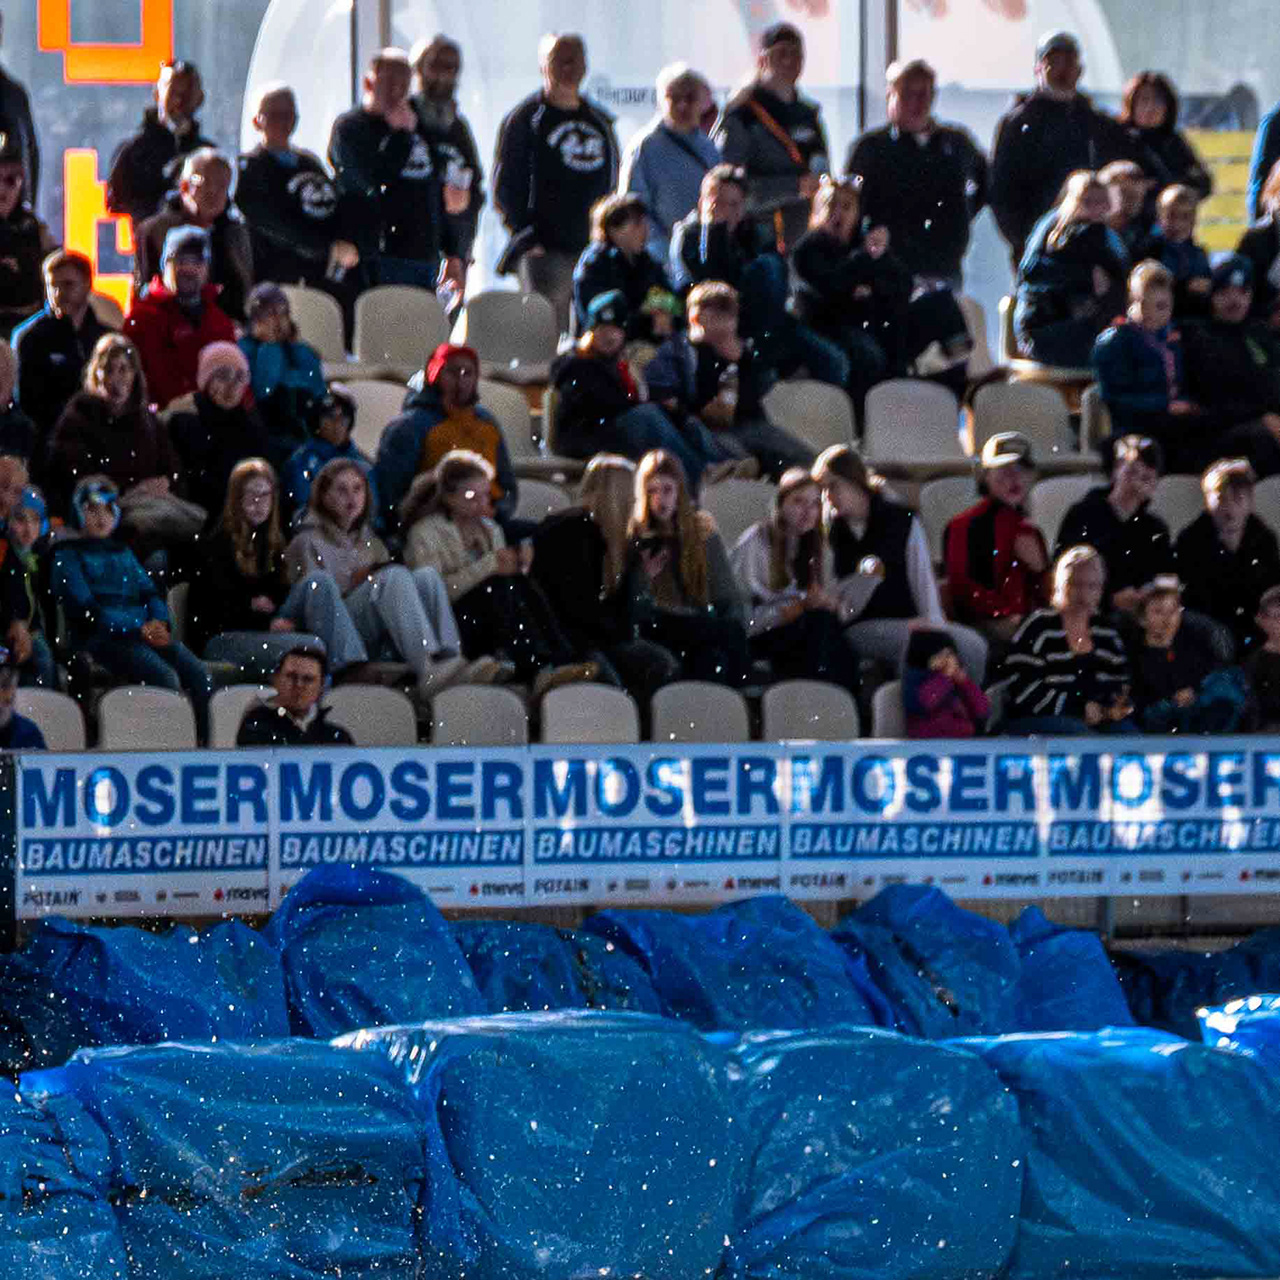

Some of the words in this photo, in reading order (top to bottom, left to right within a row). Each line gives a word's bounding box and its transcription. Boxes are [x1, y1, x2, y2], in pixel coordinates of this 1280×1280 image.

[23, 763, 269, 828] MOSER
[280, 760, 523, 821] MOSER
[533, 757, 781, 818] MOSER
[791, 755, 1036, 813] MOSER
[281, 832, 523, 865] BAUMASCHINEN
[536, 828, 778, 860] BAUMASCHINEN
[794, 824, 1036, 855] BAUMASCHINEN
[1050, 818, 1280, 849] BAUMASCHINE
[26, 836, 268, 870] BAUMASCHINEN
